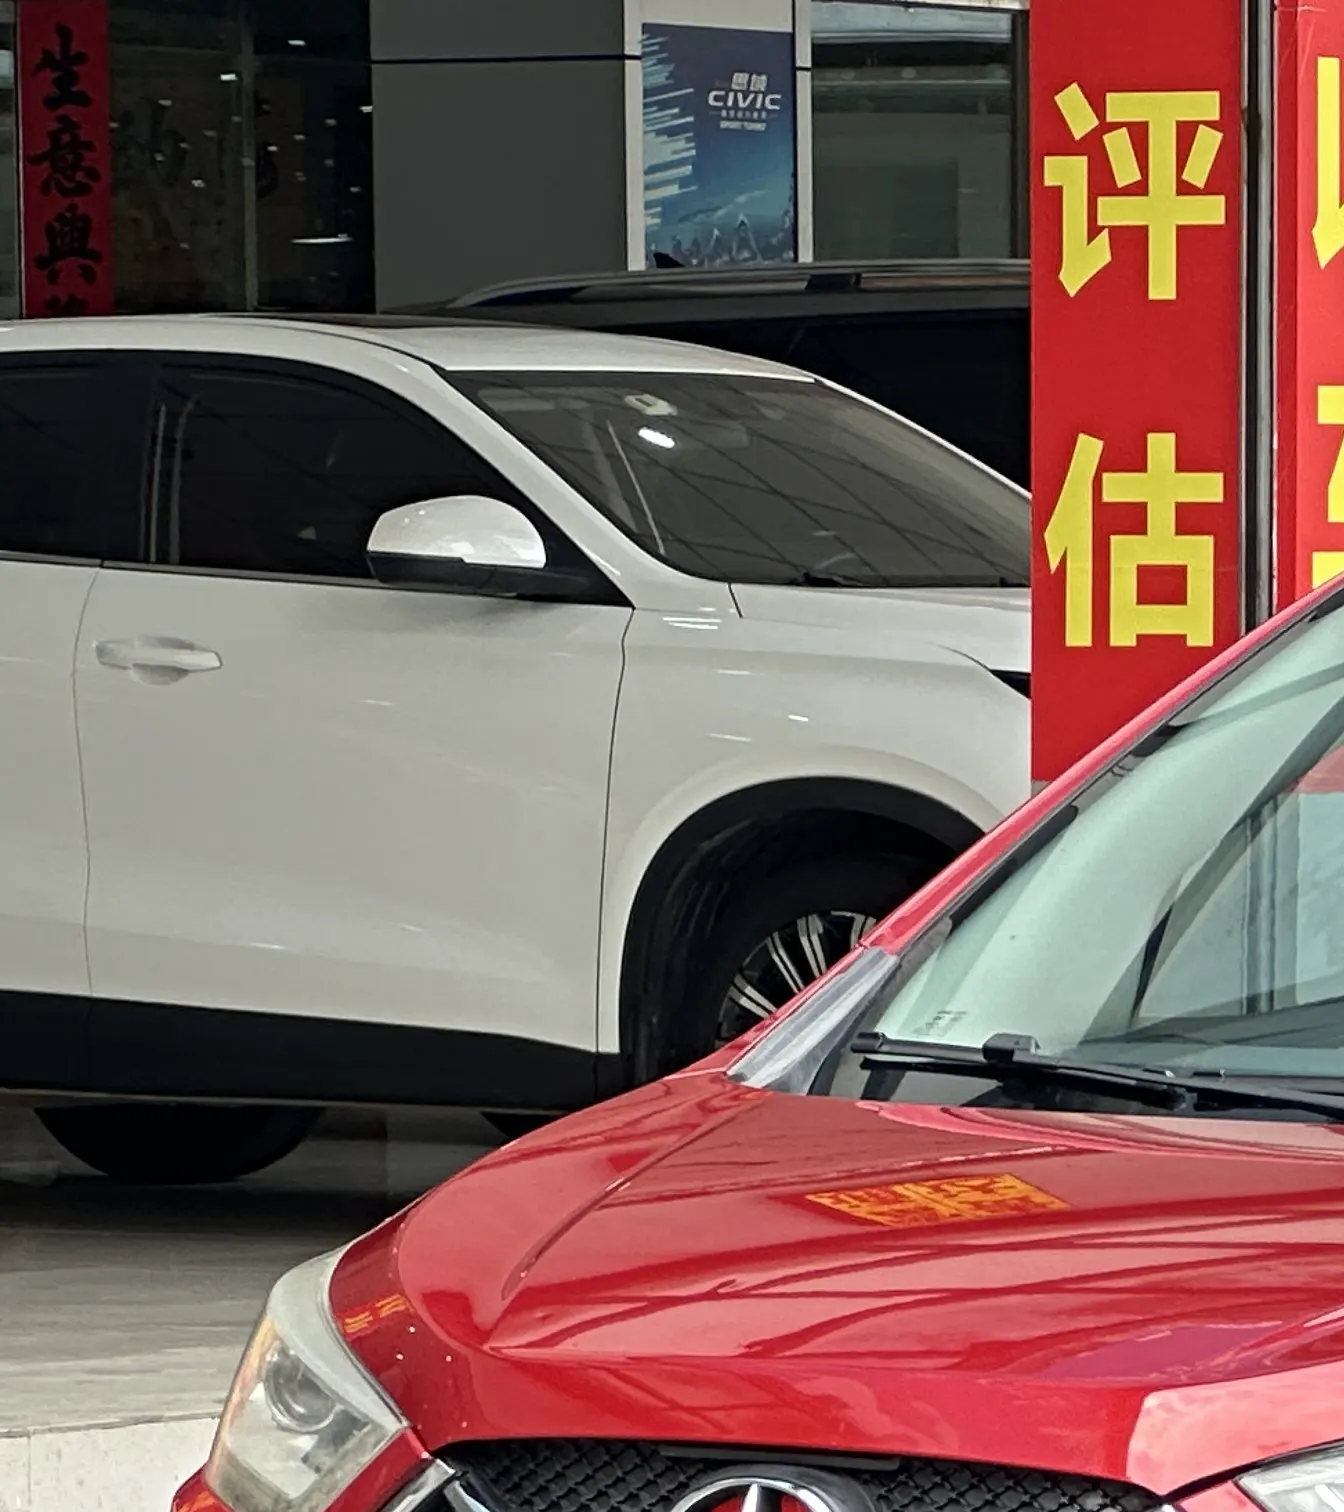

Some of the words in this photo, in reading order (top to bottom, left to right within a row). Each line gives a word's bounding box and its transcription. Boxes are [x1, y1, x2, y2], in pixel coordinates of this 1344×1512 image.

[27, 23, 103, 313] 生意興
[708, 90, 781, 110] CIVIC
[1044, 82, 1225, 648] 评估
